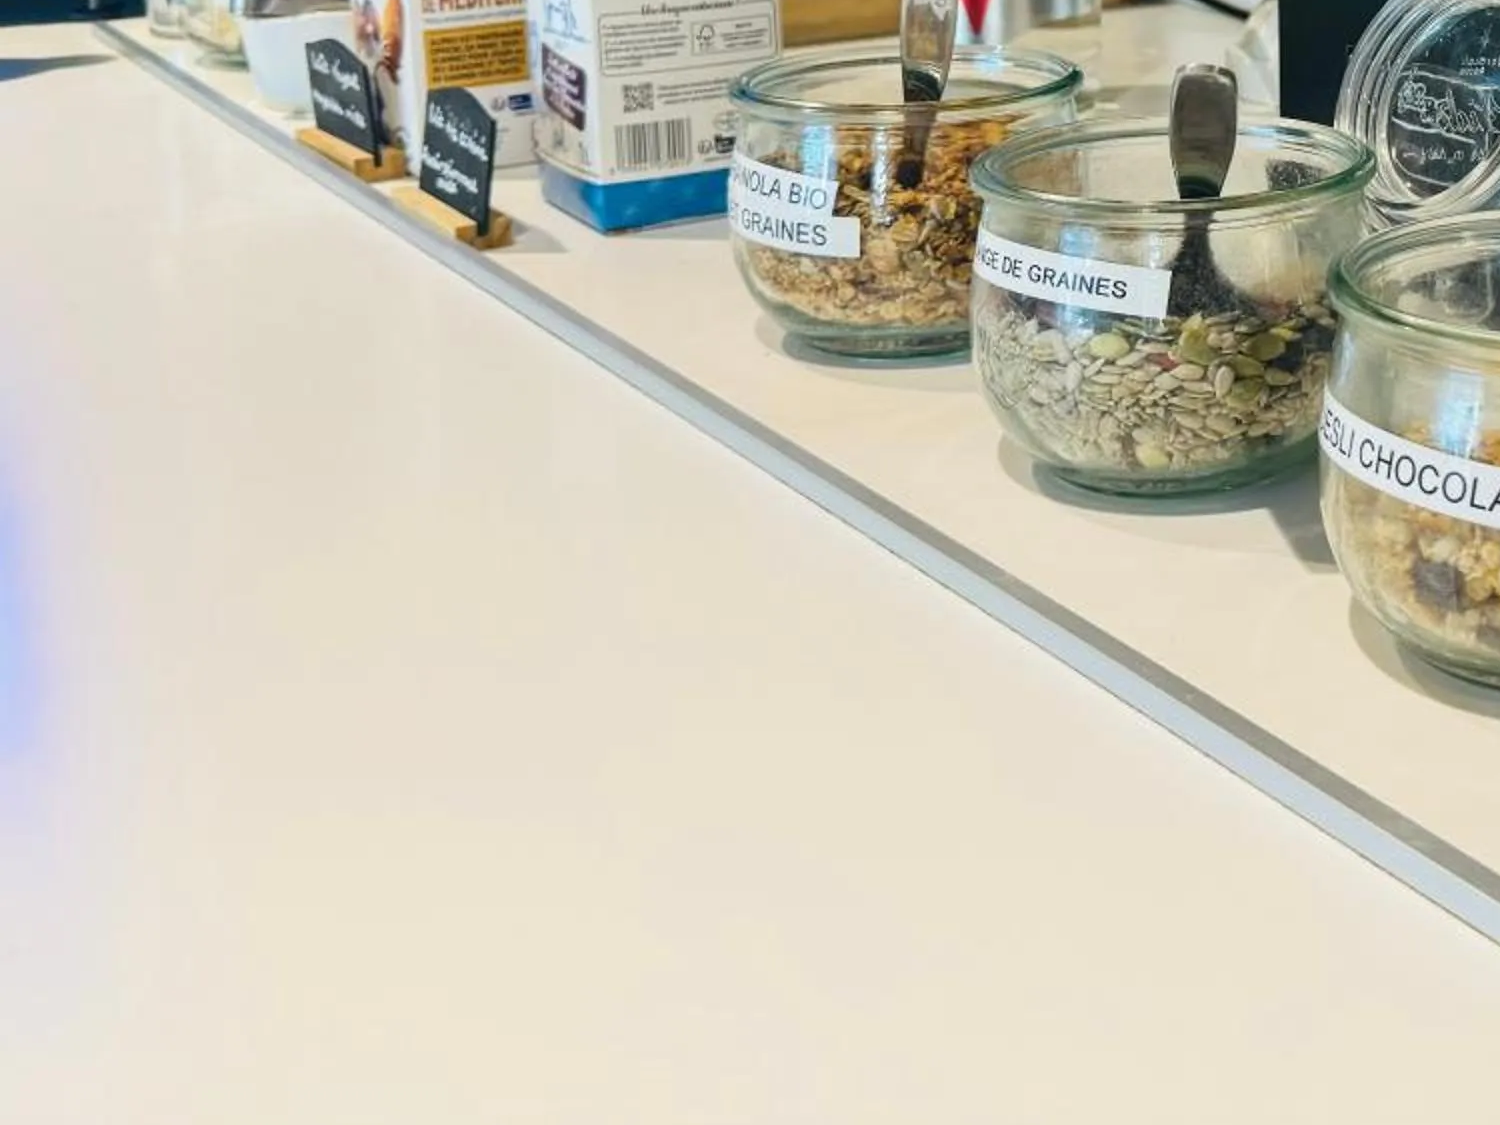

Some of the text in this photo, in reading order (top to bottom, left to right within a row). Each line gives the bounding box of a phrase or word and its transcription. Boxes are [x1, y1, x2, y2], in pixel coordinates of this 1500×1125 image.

[743, 167, 828, 210] NOLA BIO
[741, 208, 828, 246] GRAINES
[1001, 255, 1023, 278] DE
[1028, 263, 1128, 299] GRAINES
